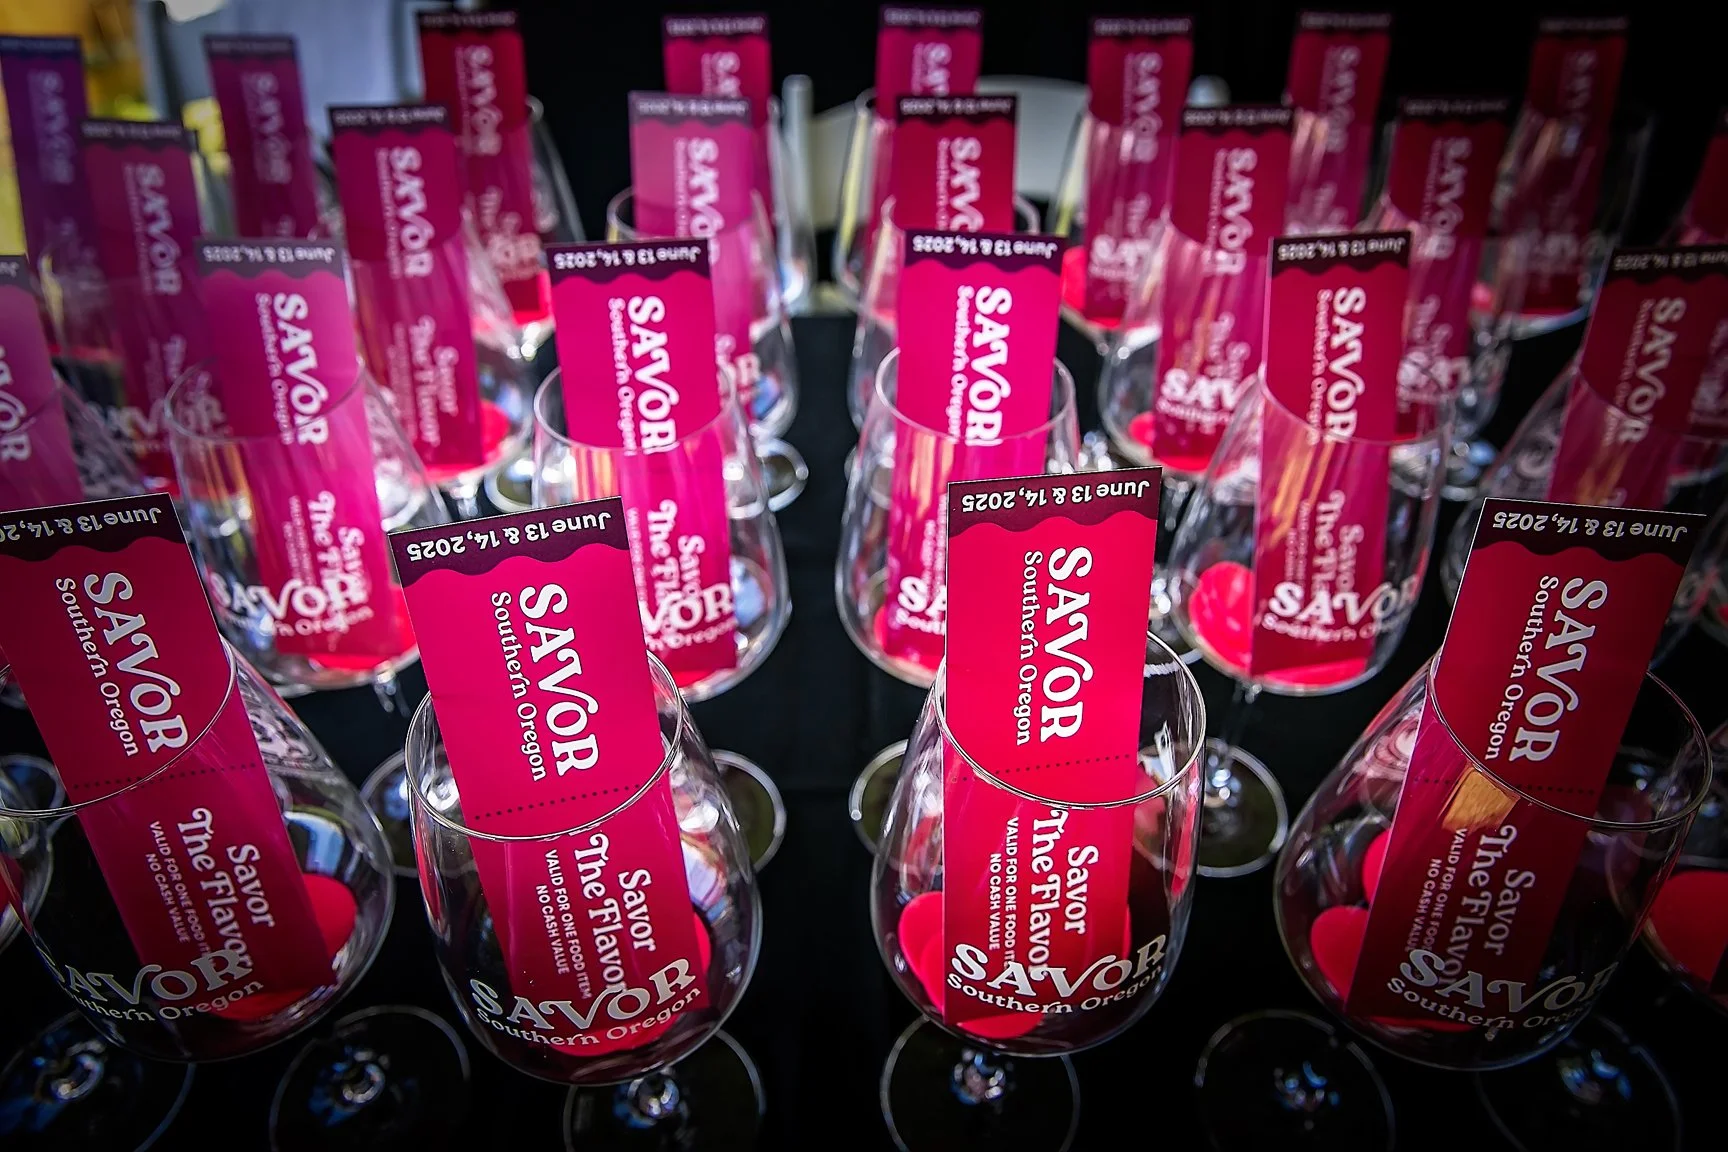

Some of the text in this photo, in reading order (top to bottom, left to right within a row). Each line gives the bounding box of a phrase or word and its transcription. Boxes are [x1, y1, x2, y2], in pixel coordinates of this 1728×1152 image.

[389, 146, 435, 277] SAVOR
[688, 137, 724, 265] SAVO
[950, 136, 985, 233] SAVO
[1216, 148, 1258, 274] SAVOR
[294, 246, 335, 264] June
[553, 251, 597, 270] 2025
[636, 247, 657, 265] 13
[656, 246, 701, 263] June
[912, 235, 955, 253] 2025
[992, 238, 1013, 256] 13
[1013, 240, 1058, 259] June
[1366, 237, 1406, 254] June
[255, 292, 283, 378] Southern
[1311, 288, 1334, 377] Southern
[273, 292, 329, 445] SAVOR
[608, 297, 637, 457] Southern Oregon
[627, 295, 680, 455] SAVOR
[946, 285, 976, 445] Southern Oregon
[965, 285, 1013, 447] SAVOR
[1161, 368, 1250, 410] SAV
[1324, 286, 1366, 444] SAVOR
[1617, 297, 1687, 443] SAVOR
[54, 518, 74, 534] &
[77, 514, 103, 532] 13
[103, 507, 162, 525] June
[647, 499, 678, 558] The
[961, 480, 1150, 513] June 13 & 14, 2025
[1314, 489, 1345, 549] The
[1492, 511, 1689, 542] June 13 & 14, 2025
[19, 520, 55, 538] 14,
[406, 511, 612, 562] June 13 & 14, 2025
[1335, 524, 1364, 594] Savo
[210, 572, 369, 619] SAVOR
[677, 534, 706, 602] Savo
[638, 582, 733, 634] VOR
[55, 577, 140, 757] Southern Oregon
[84, 572, 190, 753] SAVOR
[1013, 551, 1044, 746] Southern Oregon
[1040, 546, 1093, 742] SAVOR
[1485, 575, 1560, 760] Southern Oregon
[1509, 577, 1608, 763] SAVOR
[490, 591, 547, 782] Southern Oregon
[518, 583, 599, 776] SAVOR
[177, 807, 216, 872] The
[574, 833, 610, 900] The
[1006, 816, 1019, 856] VALID
[1031, 808, 1069, 874] The
[1427, 858, 1442, 878] NO
[1447, 828, 1468, 865] VALID
[1468, 824, 1518, 888] The
[145, 853, 191, 943] NO CASH VALUE
[150, 820, 172, 856] VALID
[164, 857, 183, 882] FOR
[174, 882, 193, 908] ONE
[184, 908, 206, 942] FOOD
[226, 843, 275, 928] Savor
[988, 853, 1002, 951] NO CASH VALUE
[1005, 858, 1018, 884] FOR
[1005, 885, 1018, 912] ONE
[1064, 845, 1099, 935] Savor
[1416, 880, 1436, 914] CASH
[1439, 866, 1457, 891] FOR
[536, 885, 570, 975] NO CASH VALUE
[545, 849, 593, 1000] VALID FOR ONE FOOD ITEM
[618, 869, 656, 952] Savor
[1004, 913, 1017, 949] FOOD
[1430, 892, 1448, 920] ONE
[1484, 869, 1536, 955] Savor
[64, 949, 253, 1005] AVOR
[469, 957, 697, 1031] SAVOR
[946, 964, 1163, 1014] Southern Oregon
[951, 934, 1167, 998] SAVOR
[159, 980, 264, 1020] Oregon
[476, 987, 701, 1047] Southern Oregon
[1387, 977, 1514, 1029] Southern
